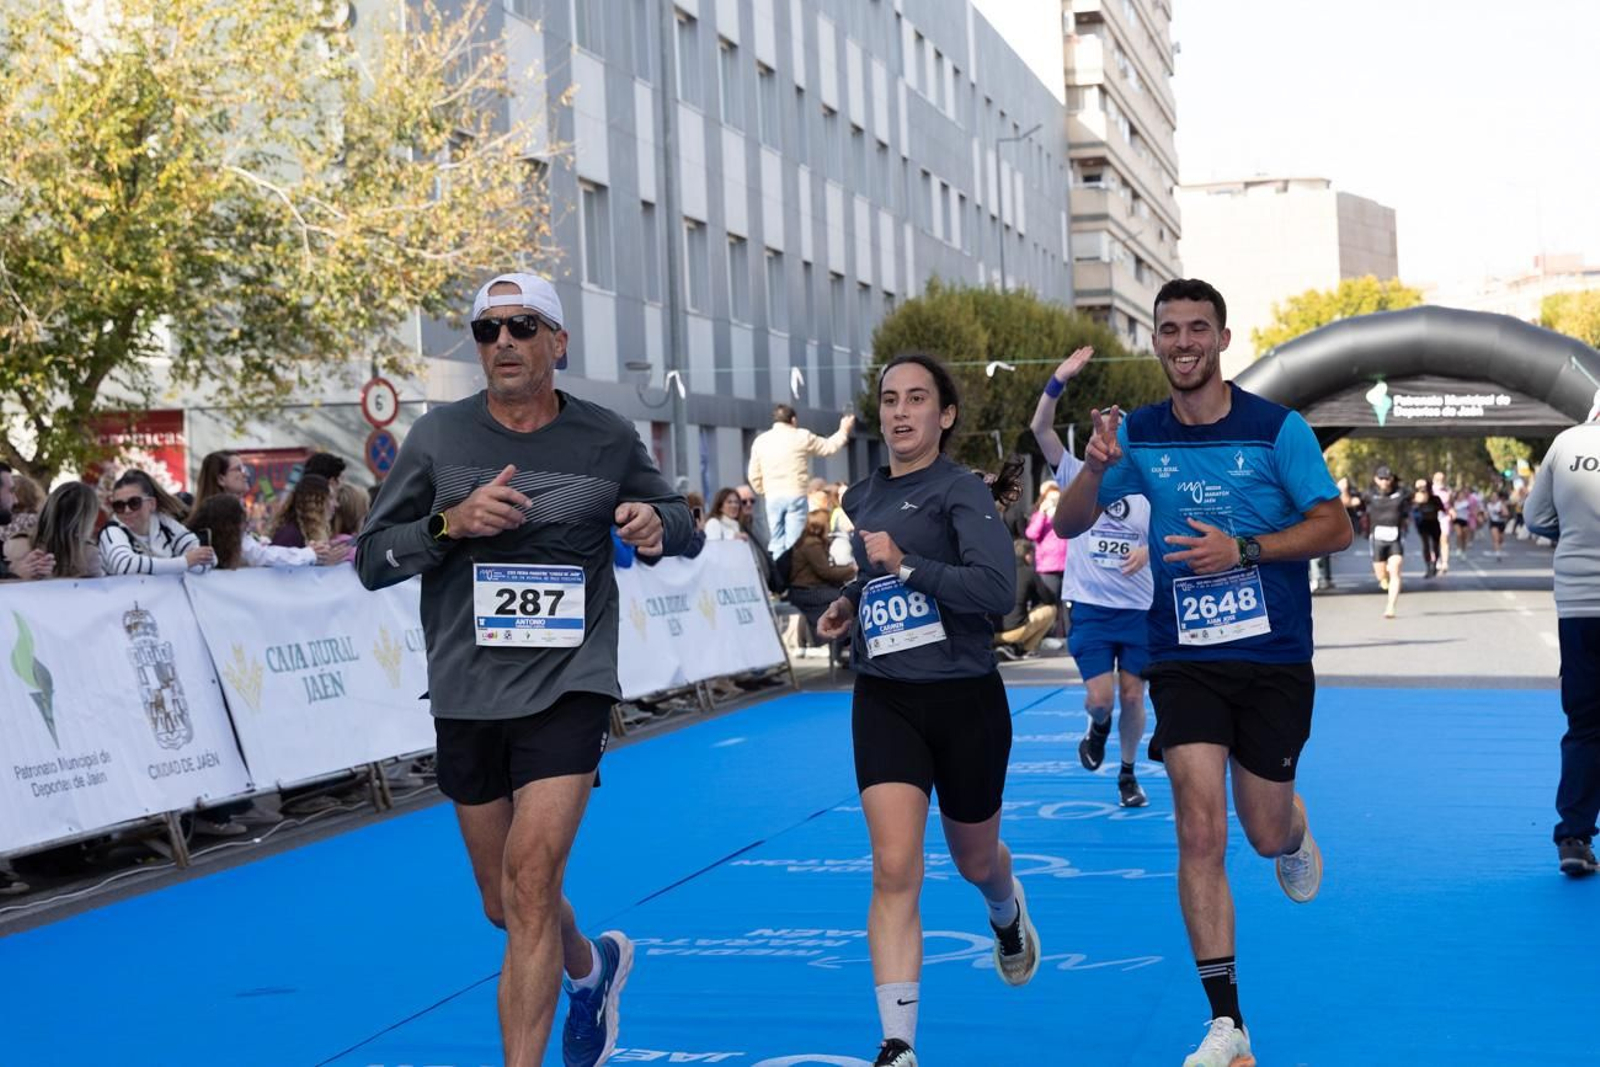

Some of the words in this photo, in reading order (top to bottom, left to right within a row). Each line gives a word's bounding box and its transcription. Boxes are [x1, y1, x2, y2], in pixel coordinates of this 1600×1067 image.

[375, 393, 384, 412] 6
[1569, 455, 1600, 472] JO
[1098, 540, 1130, 555] 926
[494, 588, 565, 616] 287
[862, 591, 929, 631] 2608
[1182, 587, 1257, 621] 2648
[515, 618, 546, 626] ANTONIO
[880, 622, 904, 632] CARMEN
[266, 643, 310, 674] CAJA
[307, 636, 360, 668] RURAL
[302, 668, 346, 704] JAÉN
[13, 761, 58, 780] Patronato
[57, 752, 99, 771] Municipal
[99, 749, 112, 763] de
[148, 760, 182, 780] CIUDAD
[180, 757, 195, 773] DE
[31, 780, 72, 798] Deportes
[72, 775, 85, 789] de
[646, 948, 824, 956] MEDIA
[610, 1048, 747, 1063] JAÉ
